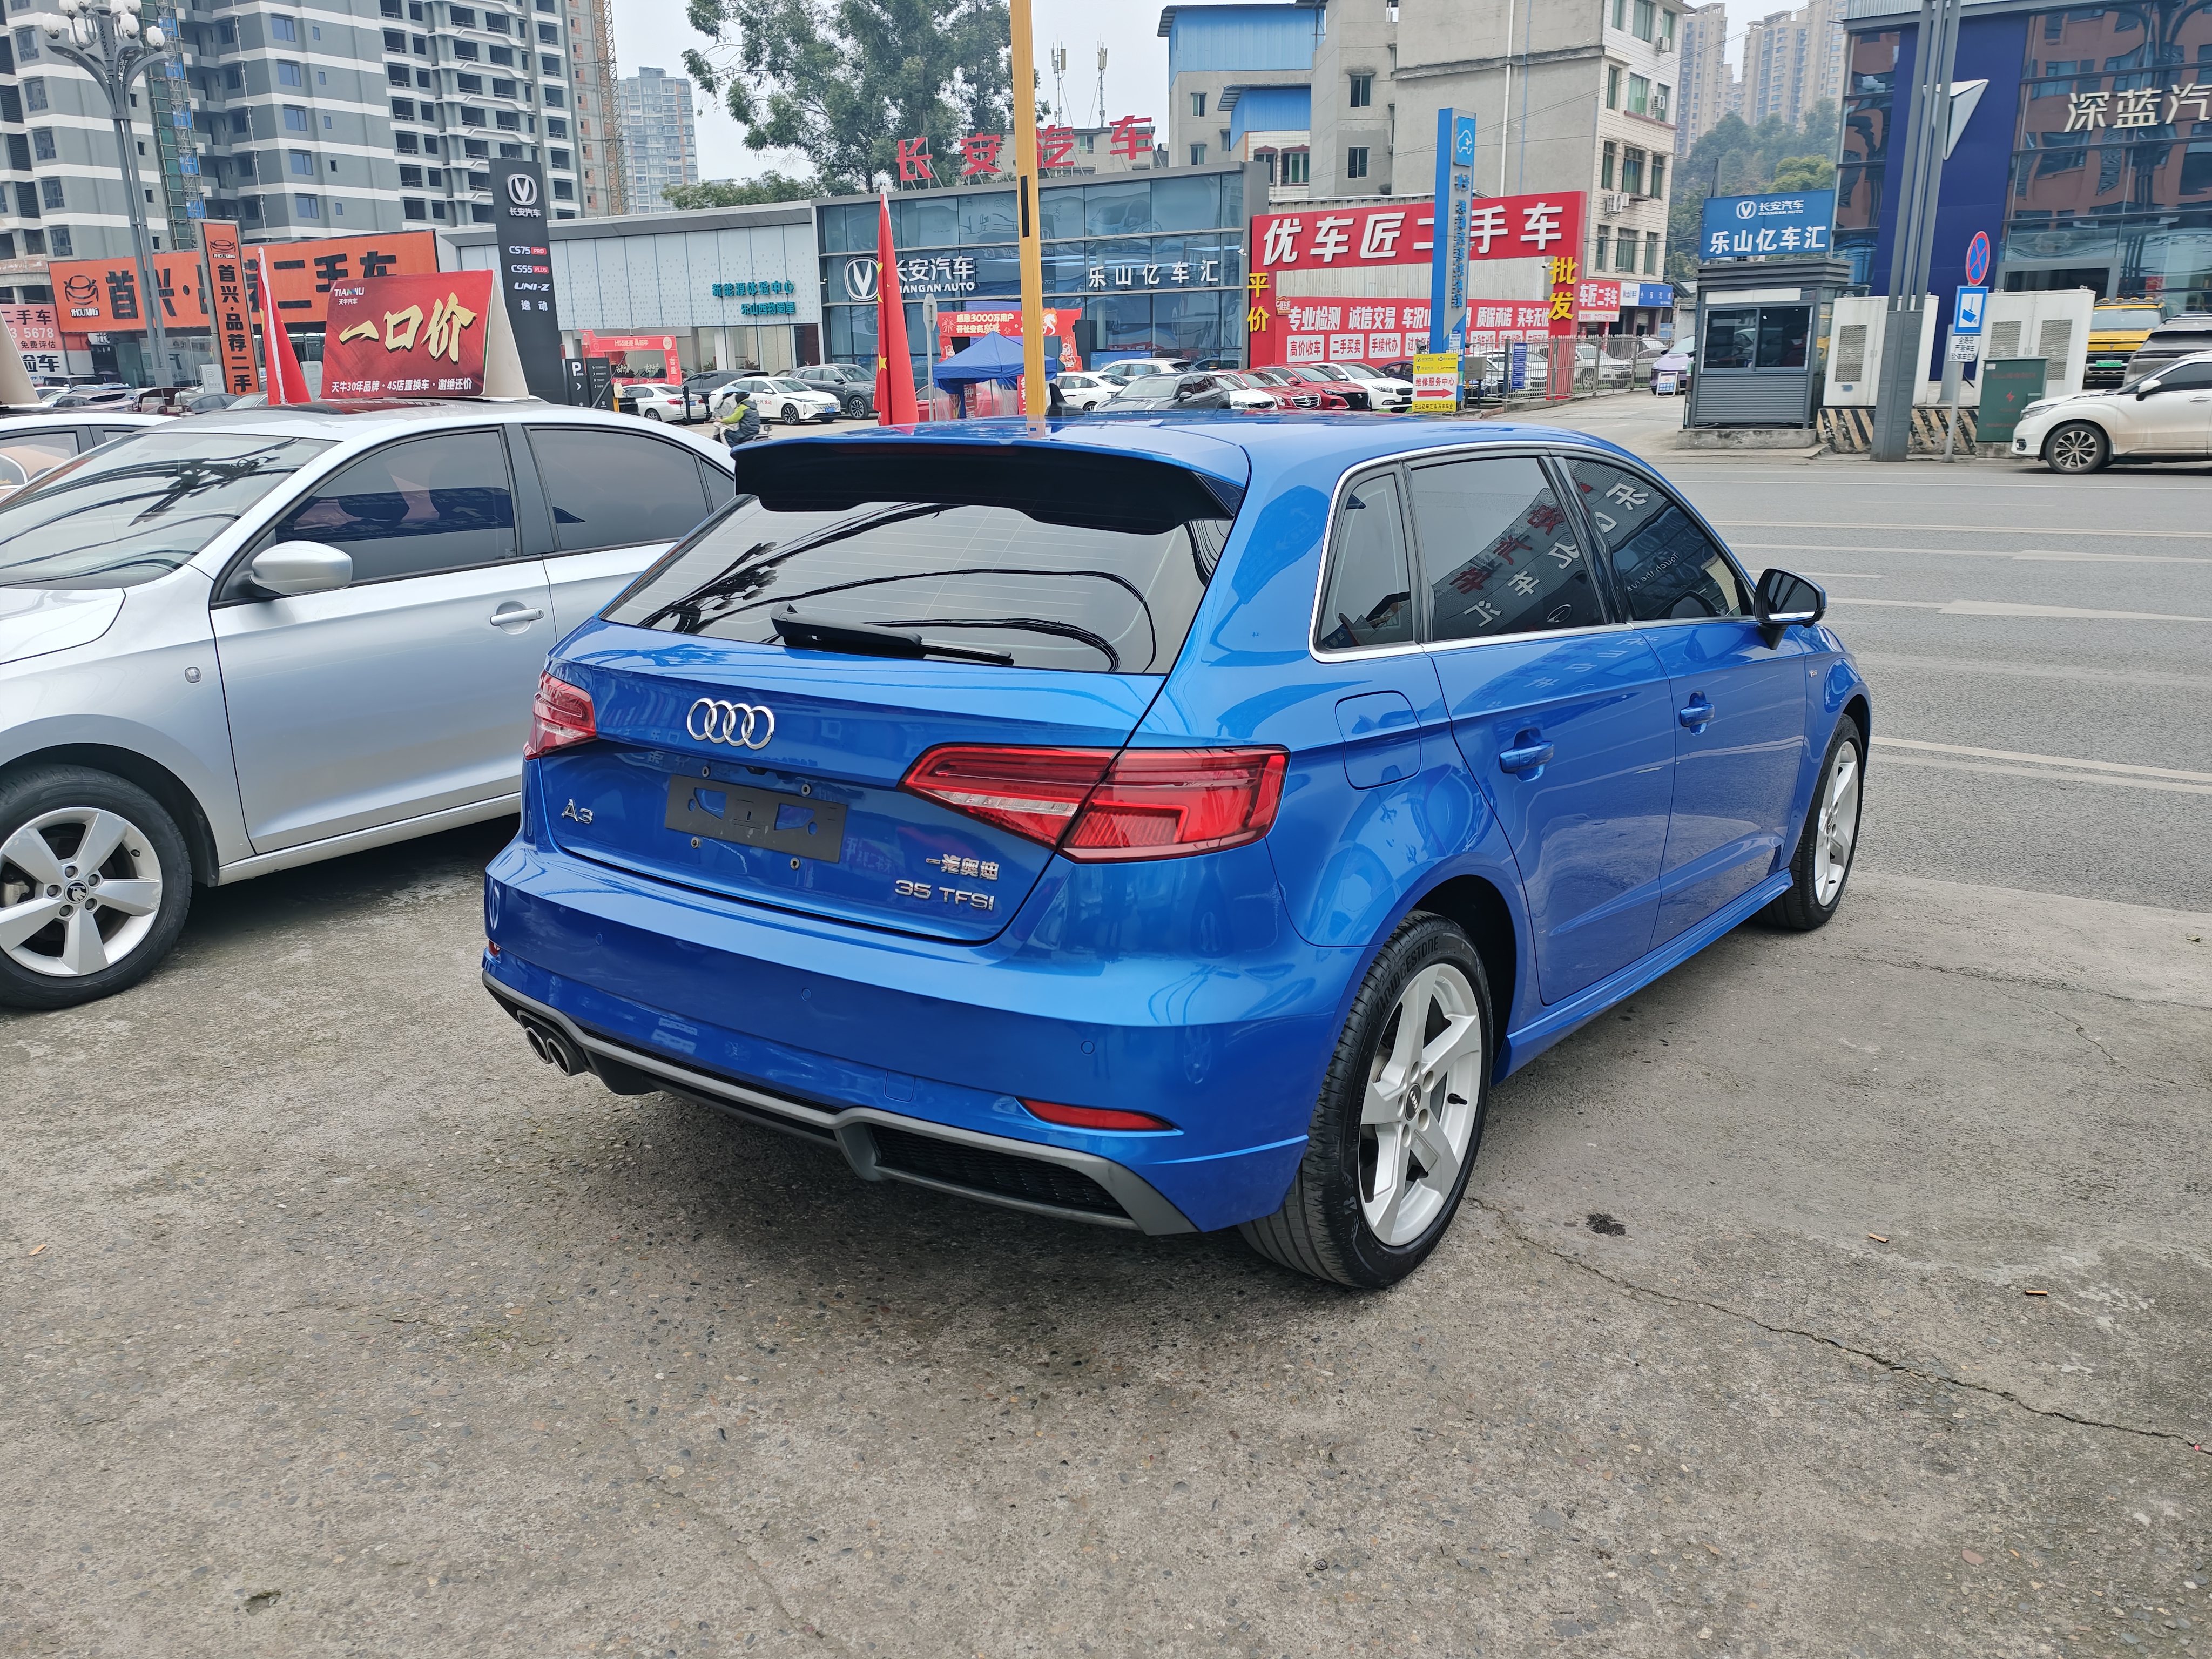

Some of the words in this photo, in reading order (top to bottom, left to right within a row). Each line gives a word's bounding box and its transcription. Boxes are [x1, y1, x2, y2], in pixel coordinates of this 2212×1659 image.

[895, 115, 1153, 181] 长安汽车
[509, 207, 541, 218] 长安汽车
[1759, 200, 1805, 212] 长安汽车
[1263, 202, 1564, 266] 优车匠二手车
[1709, 226, 1827, 254] 乐山亿车汇
[509, 246, 531, 255] CS75
[511, 265, 533, 273] CS55
[896, 256, 974, 282] 长安汽车
[1088, 259, 1219, 288] 乐山亿车汇
[514, 282, 550, 291] UNI-Z
[711, 280, 795, 297] 新能源体验中心
[944, 282, 975, 292] AUTO
[1548, 257, 1579, 320] 批发
[1246, 273, 1271, 332] 平价
[339, 292, 477, 362] 一口价
[1287, 306, 1342, 331] 专业检测
[1348, 306, 1396, 330] 诚信交易
[1476, 306, 1513, 328] 质保承诺
[24, 328, 54, 339] 5678
[20, 340, 56, 349] 免费评估
[1290, 340, 1321, 356] 高价收车
[1332, 338, 1361, 354] 二手买卖
[1372, 336, 1398, 353] 手续代办
[1415, 377, 1454, 386] 维修服务中心
[561, 799, 594, 824] A3
[926, 854, 999, 881] 一汽奥迪
[894, 879, 932, 899] 35
[939, 886, 995, 911] TFSI
